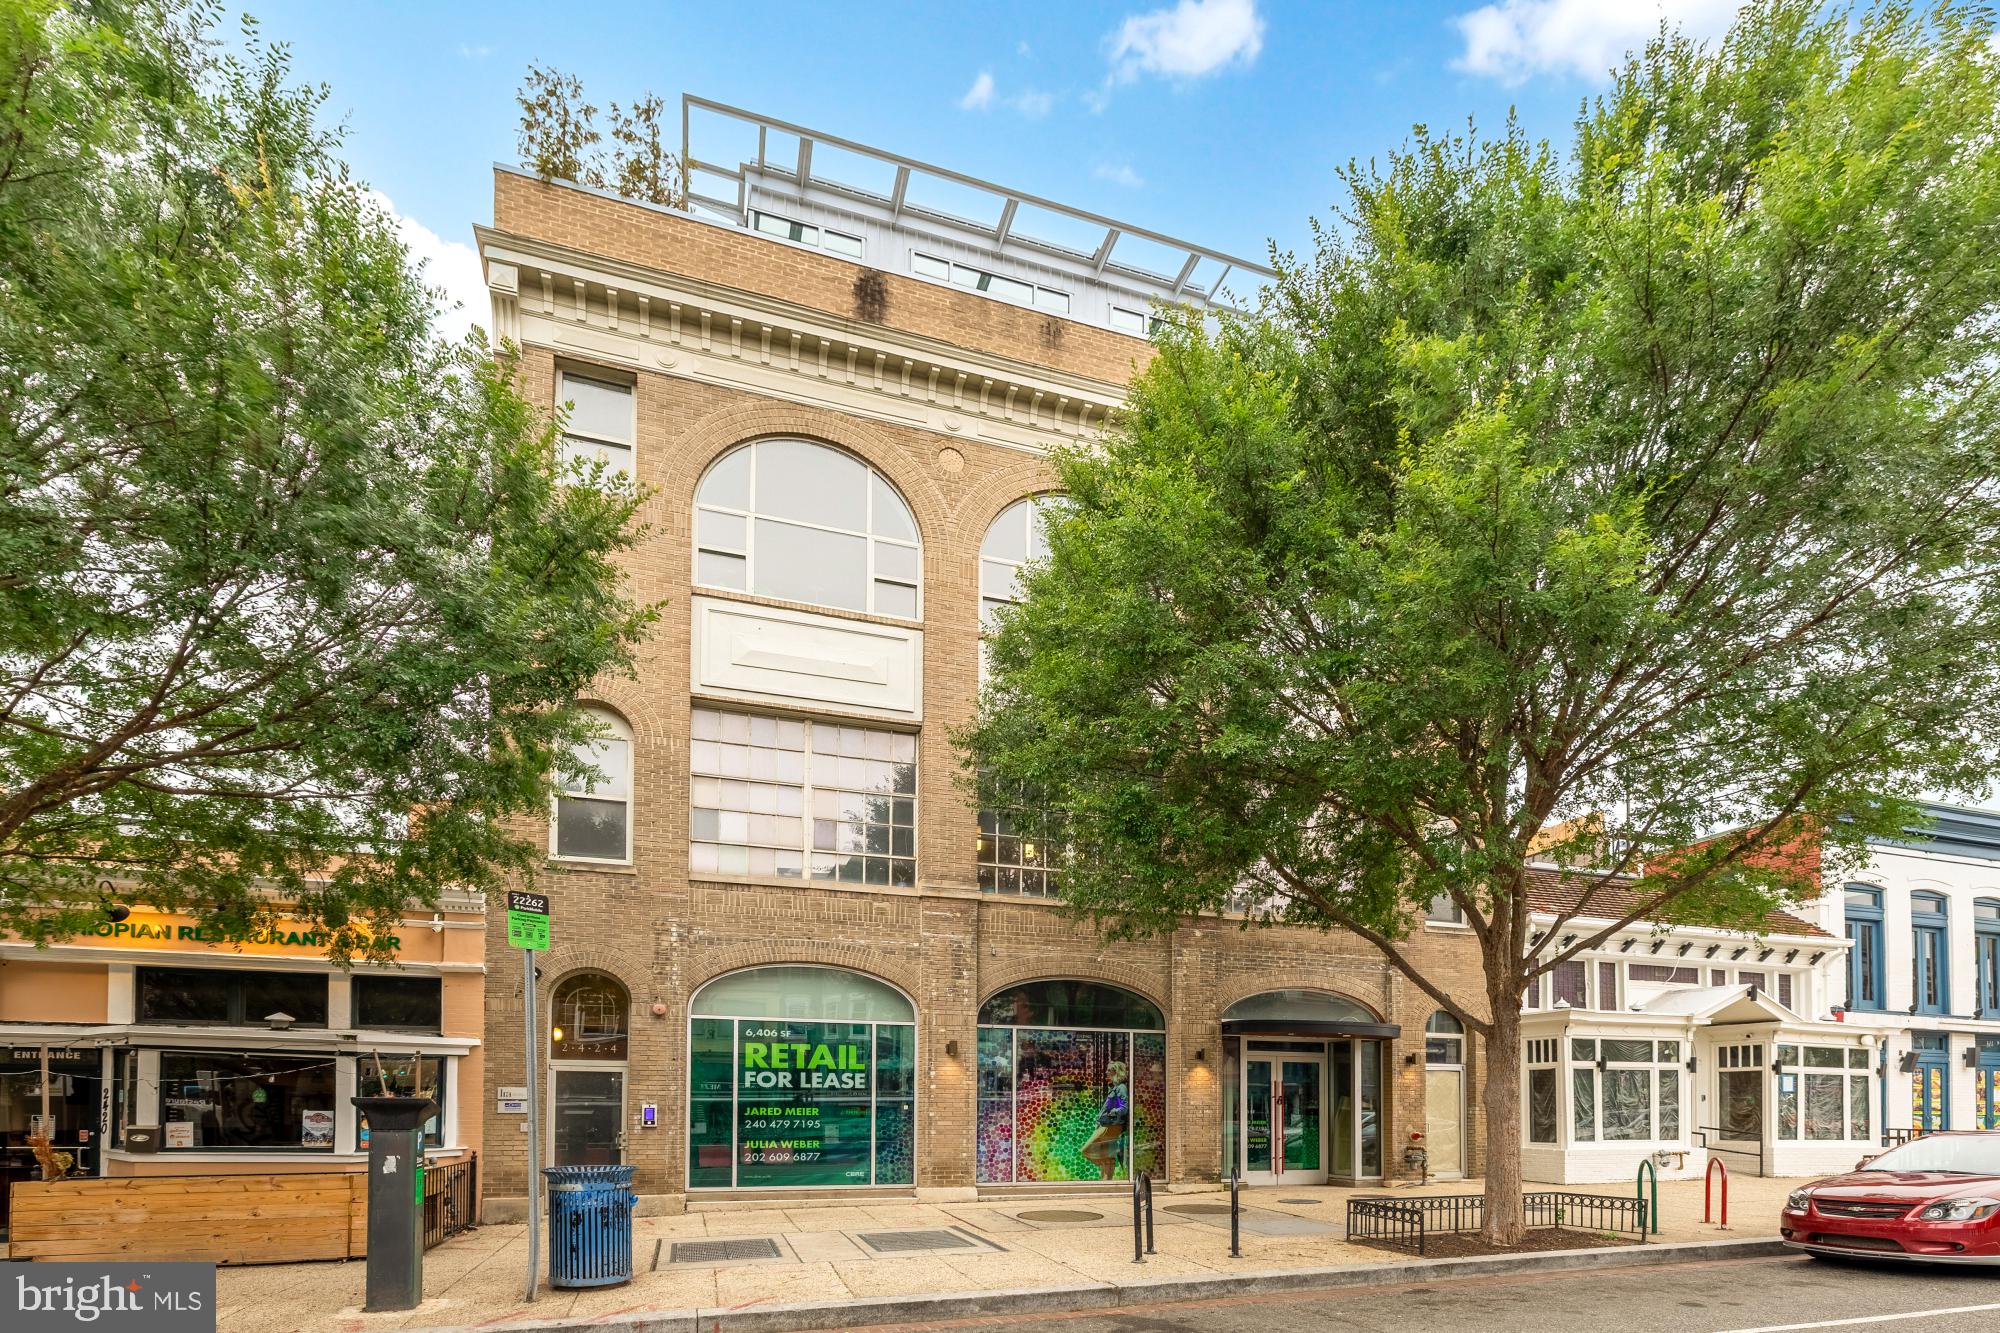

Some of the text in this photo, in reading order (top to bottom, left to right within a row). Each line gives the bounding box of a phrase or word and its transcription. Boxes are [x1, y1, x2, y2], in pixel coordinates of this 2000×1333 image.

[513, 895, 544, 907] 22262
[46, 919, 171, 940] IOPIAN
[178, 925, 326, 947] REURANT
[745, 1028, 792, 1038] 6,406 SF
[14, 1051, 81, 1060] ENTANCE
[745, 1042, 866, 1070] RETAIL
[744, 1071, 866, 1089] FOR LEASE
[101, 1088, 109, 1134] 2420
[744, 1107, 820, 1116] JARED MEIER
[745, 1120, 821, 1129] 240 479 7195
[744, 1140, 820, 1149] JULIA WEBER
[744, 1152, 821, 1162] 202 609 6877
